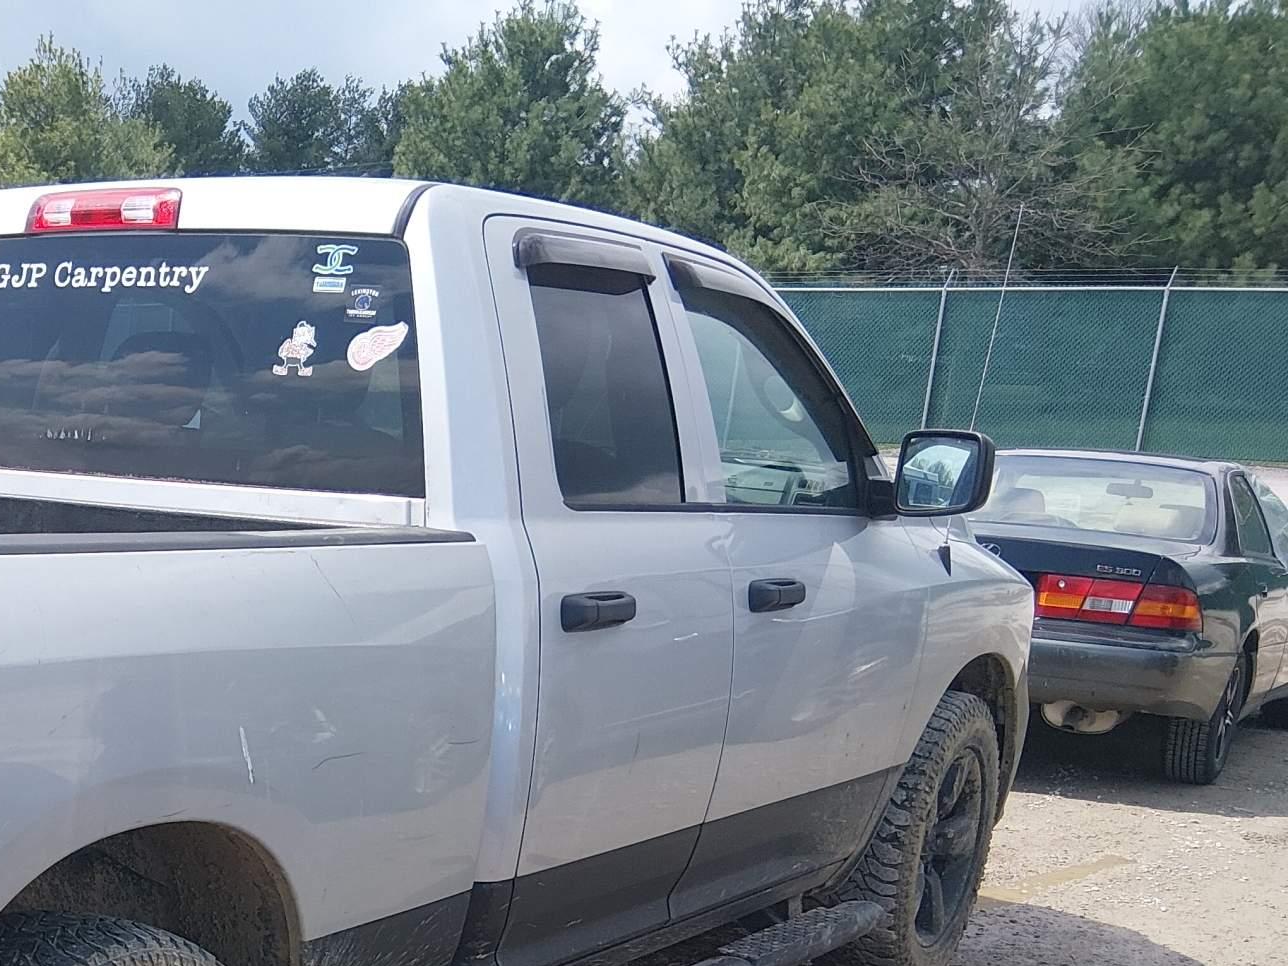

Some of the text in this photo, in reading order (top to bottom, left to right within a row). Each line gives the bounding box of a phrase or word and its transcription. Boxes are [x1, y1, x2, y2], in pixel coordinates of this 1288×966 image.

[54, 261, 209, 294] Carpentry
[1096, 564, 1142, 577] ES 300
